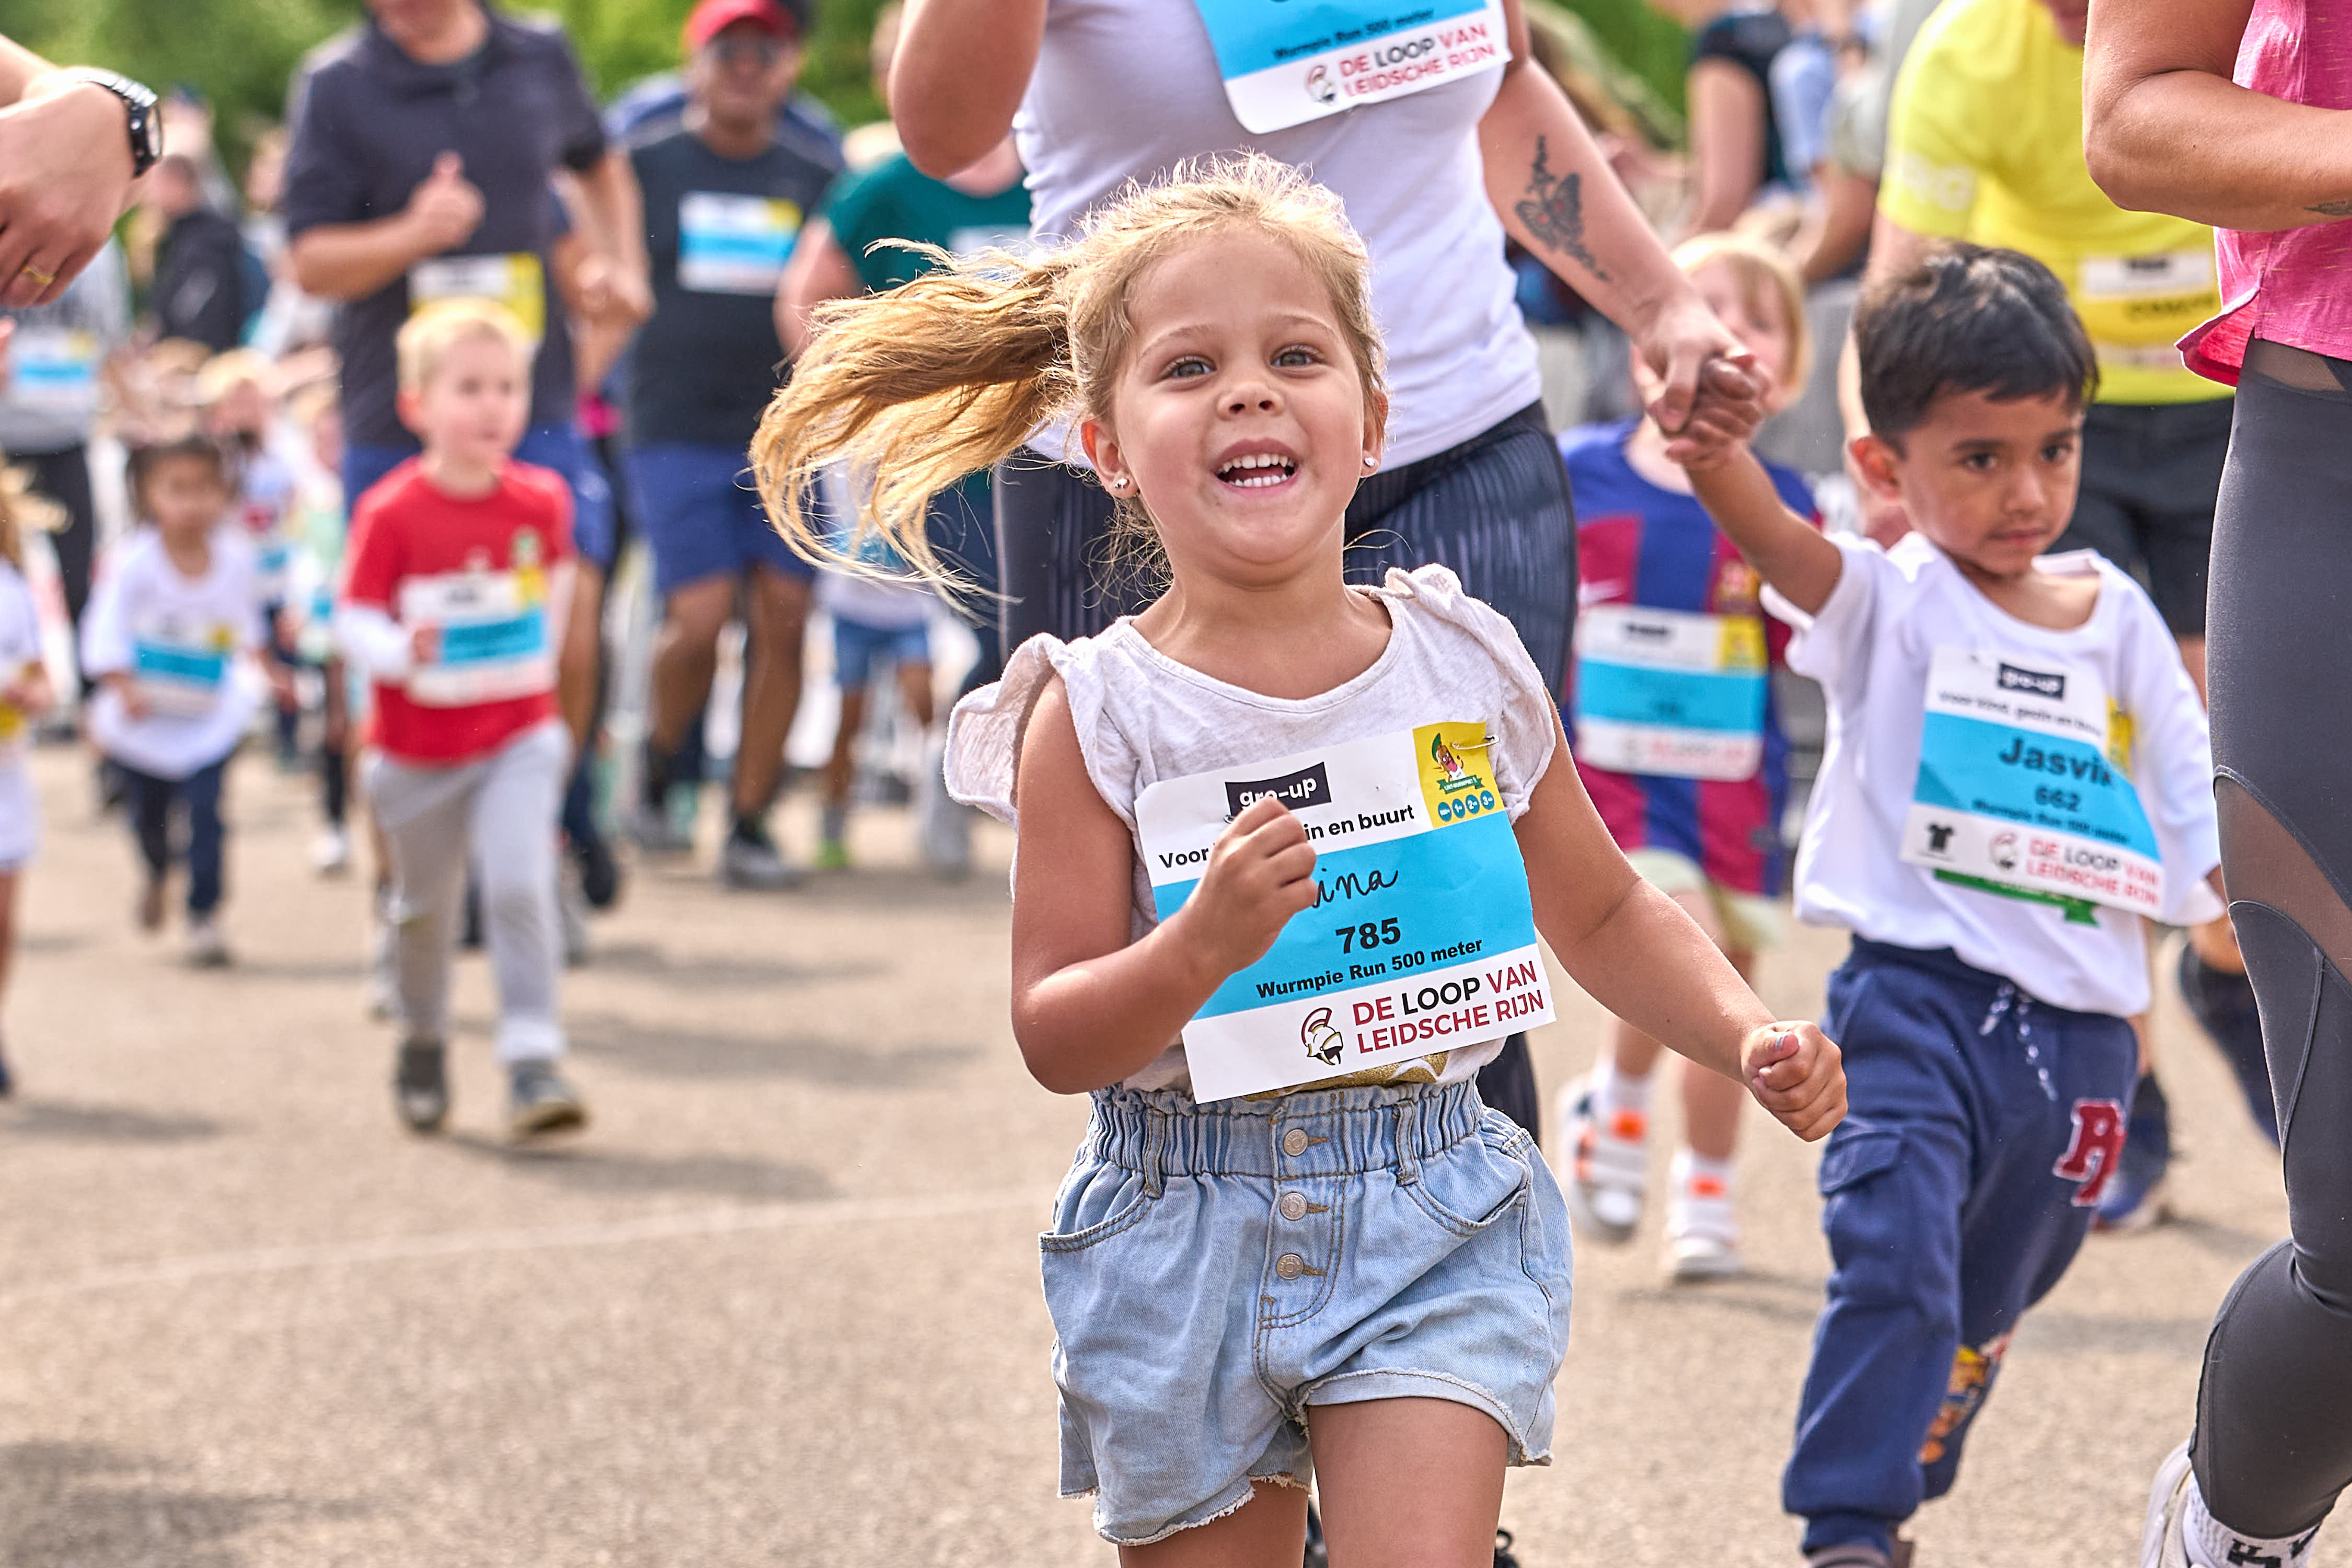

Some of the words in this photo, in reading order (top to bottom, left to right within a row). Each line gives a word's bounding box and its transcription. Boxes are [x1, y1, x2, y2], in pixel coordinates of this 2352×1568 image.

[1339, 55, 1371, 77] DE
[1374, 38, 1435, 67] LOOP
[1437, 23, 1488, 49] VAN
[1343, 59, 1445, 97] LEIDSCHE
[1159, 848, 1209, 868] Voor
[1329, 820, 1354, 835] en
[1358, 804, 1414, 829] buurt
[1312, 868, 1398, 908] ina
[1335, 917, 1401, 954] 785
[1256, 970, 1344, 998] Wurmpie
[1350, 962, 1386, 980] Run
[1392, 950, 1425, 971] 500
[1431, 939, 1482, 962] meter
[1352, 996, 1394, 1026] DE
[1401, 977, 1480, 1016] LOOP
[1486, 960, 1537, 994] VAN
[1357, 1005, 1490, 1054] LEIDSCHE
[1495, 989, 1544, 1022] RIJN
